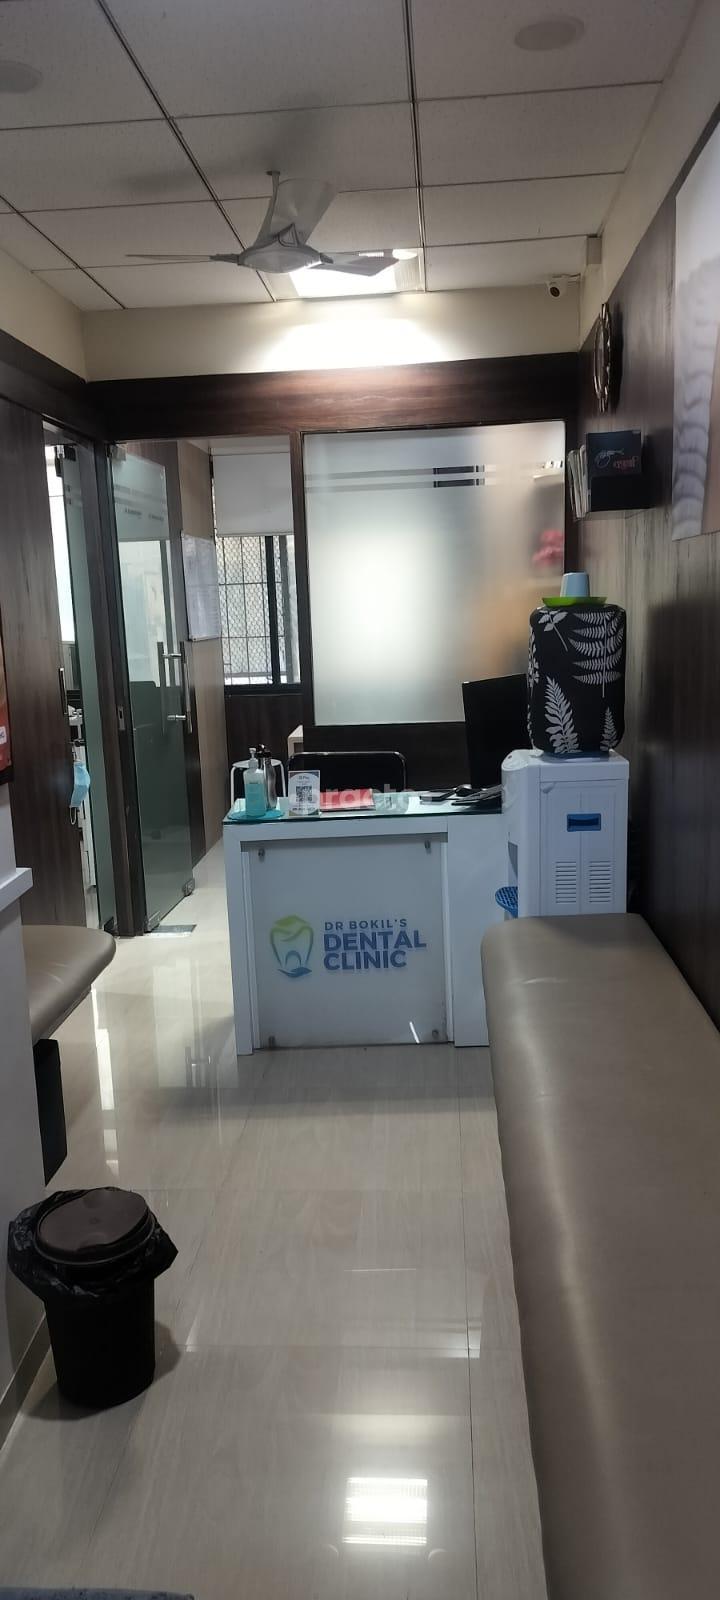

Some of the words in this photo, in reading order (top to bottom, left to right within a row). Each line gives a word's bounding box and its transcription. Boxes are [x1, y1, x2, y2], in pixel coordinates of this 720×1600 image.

[324, 921, 344, 931] DR
[349, 918, 407, 930] BOKIL'S
[324, 930, 427, 951] DENTAL
[323, 950, 407, 971] CLINIC
